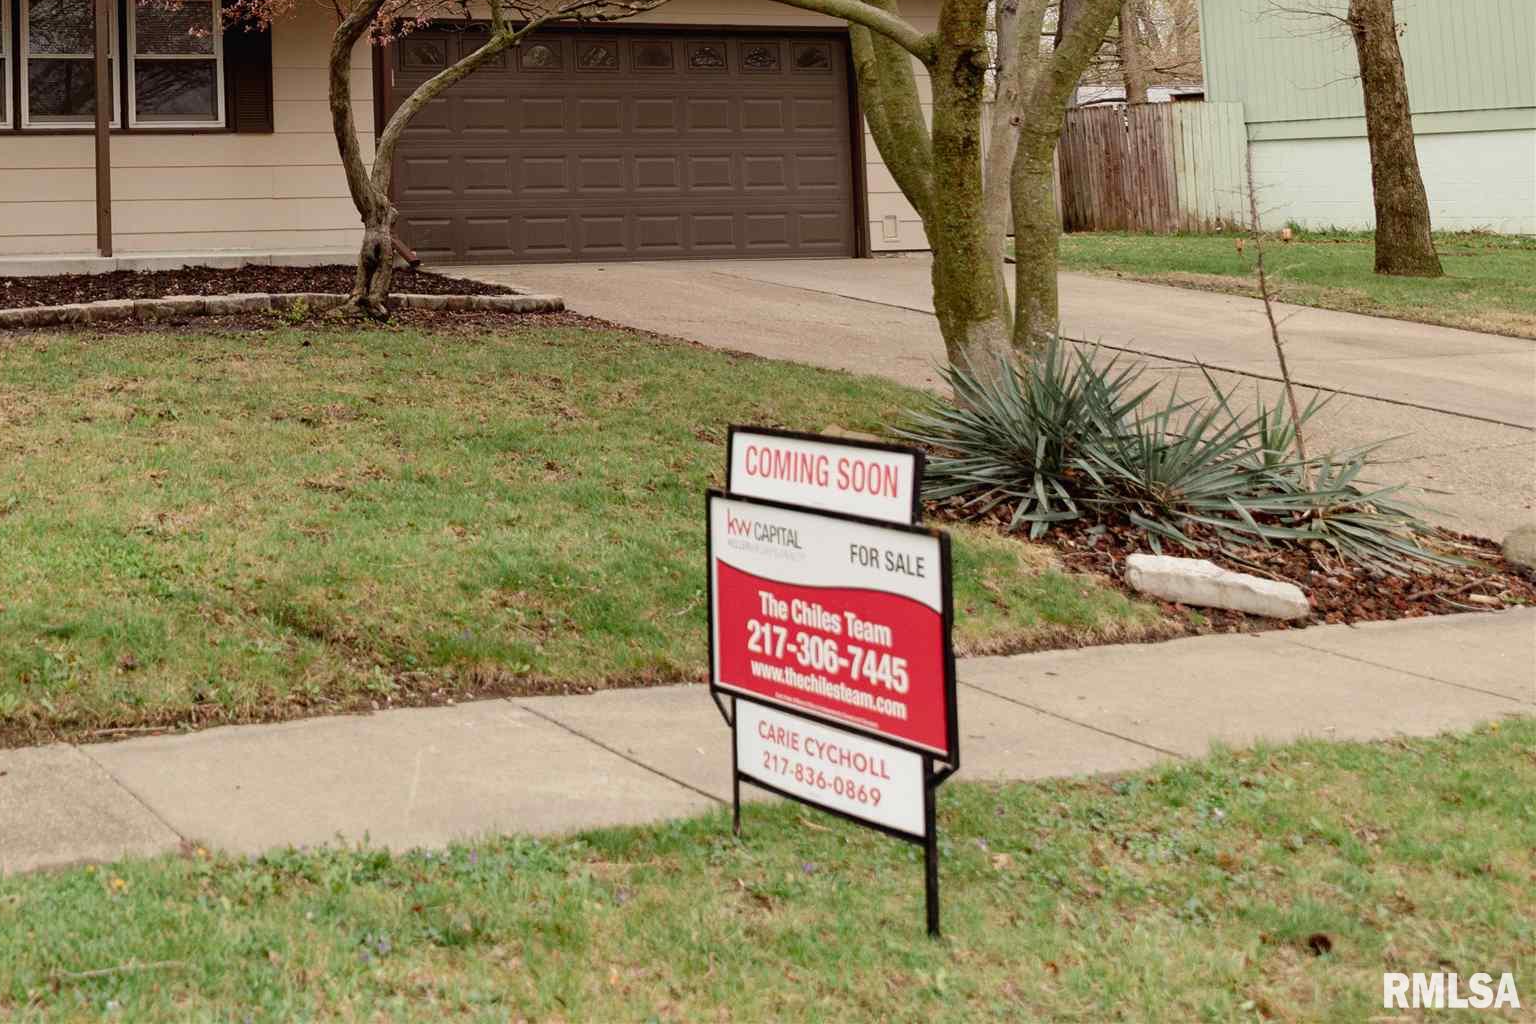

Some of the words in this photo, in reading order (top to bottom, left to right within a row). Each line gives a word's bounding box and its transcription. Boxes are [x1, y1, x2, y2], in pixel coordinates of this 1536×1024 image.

[745, 445, 829, 487] COMING
[837, 458, 899, 498] SOON
[754, 521, 802, 550] CAPITAL
[850, 544, 880, 569] FOR
[885, 550, 926, 578] SALE
[758, 590, 788, 621] The
[791, 598, 842, 635] Chiles
[844, 611, 892, 647] Team
[747, 619, 909, 694] 217-306-7445
[750, 660, 908, 720] www.thechilesteam.com
[758, 720, 800, 751] CARIE
[804, 737, 890, 780] CYCHOLL
[763, 751, 881, 807] 217-836-0869
